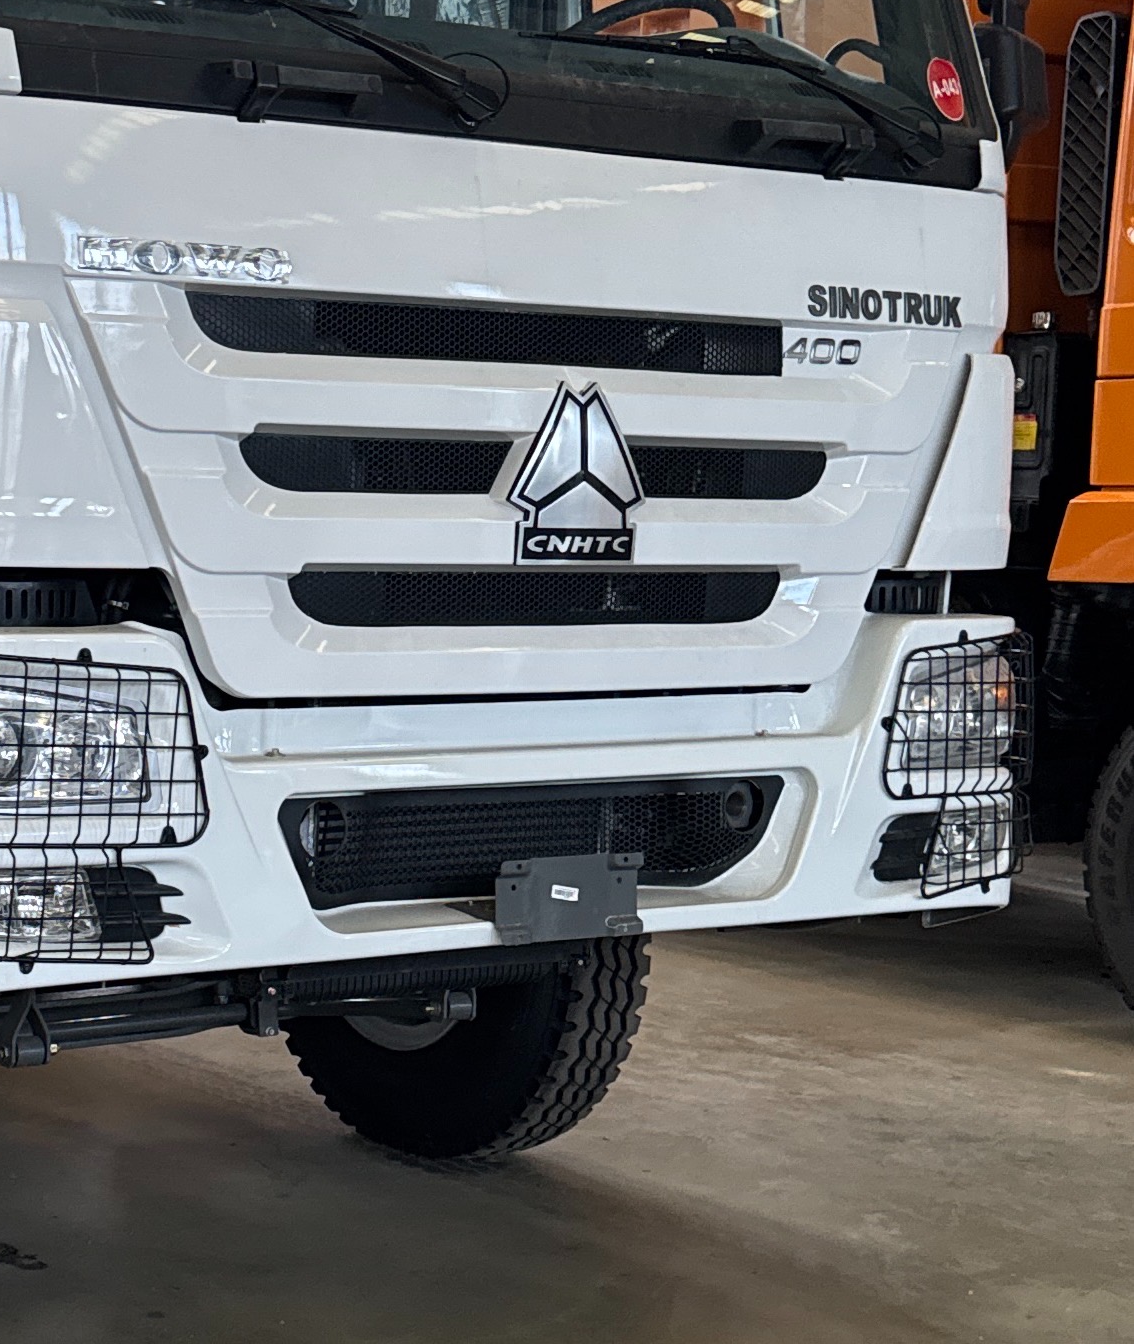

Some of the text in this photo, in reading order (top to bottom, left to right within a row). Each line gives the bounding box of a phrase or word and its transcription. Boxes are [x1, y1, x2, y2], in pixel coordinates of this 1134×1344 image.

[807, 284, 962, 328] SINOTRUK
[783, 337, 861, 365] 400
[526, 535, 630, 554] CNHTC
